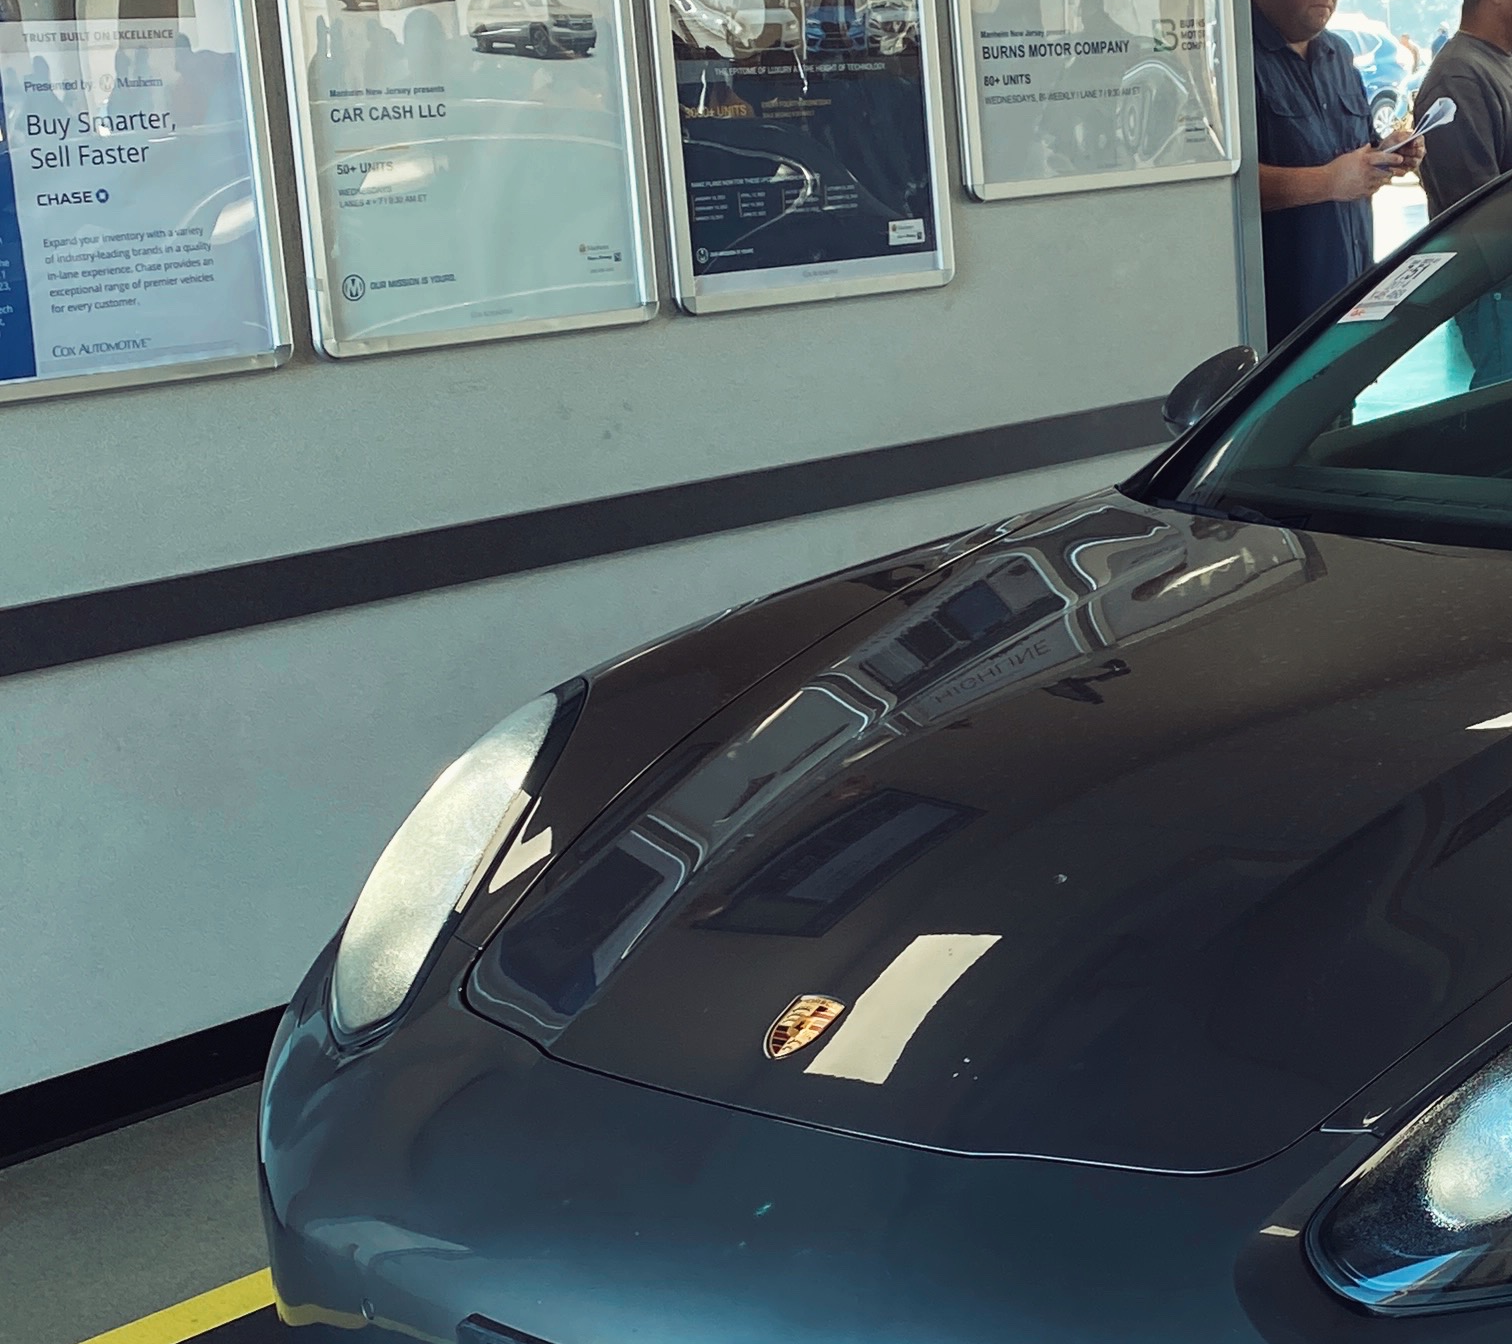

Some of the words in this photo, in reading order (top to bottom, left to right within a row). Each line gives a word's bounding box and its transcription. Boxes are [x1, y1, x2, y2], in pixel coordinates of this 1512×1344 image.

[22, 32, 58, 43] TRUST
[60, 31, 90, 42] BUILT
[93, 31, 110, 41] ON
[113, 29, 174, 41] EXCELLENCE
[982, 45, 1025, 60] BURNS
[1028, 42, 1071, 57] MOTOR
[1074, 40, 1130, 55] COMPANY
[24, 80, 78, 92] Presented
[1003, 74, 1031, 86] UNITS
[330, 107, 365, 123] CAR
[369, 105, 414, 121] CASH
[419, 103, 447, 118] LLC
[717, 105, 747, 117] UNITS
[27, 114, 70, 141] Buy
[78, 111, 176, 134] Smarter,
[31, 145, 70, 169] Sell
[79, 143, 150, 166] Faster
[337, 164, 357, 175] 50+
[360, 161, 394, 173] UNITS
[37, 191, 94, 206] CHASE
[43, 237, 77, 249] Expand
[79, 235, 99, 247] your
[102, 230, 145, 243] inventory
[146, 229, 165, 239] with
[45, 254, 55, 264] of
[57, 249, 131, 263] industry-leading
[132, 244, 163, 257] brands
[164, 244, 173, 254] in
[176, 245, 181, 253] a
[48, 269, 79, 280] in-lane
[81, 265, 133, 278] experience.
[135, 262, 162, 273] Chase
[164, 258, 201, 272] provides
[203, 258, 214, 267] an
[49, 284, 102, 298] exceptional
[104, 282, 130, 294] range
[132, 279, 142, 289] of
[143, 277, 178, 291] premier
[180, 273, 214, 284] vehicles
[51, 303, 64, 313] for
[67, 302, 92, 314] every
[94, 297, 140, 310] customer.
